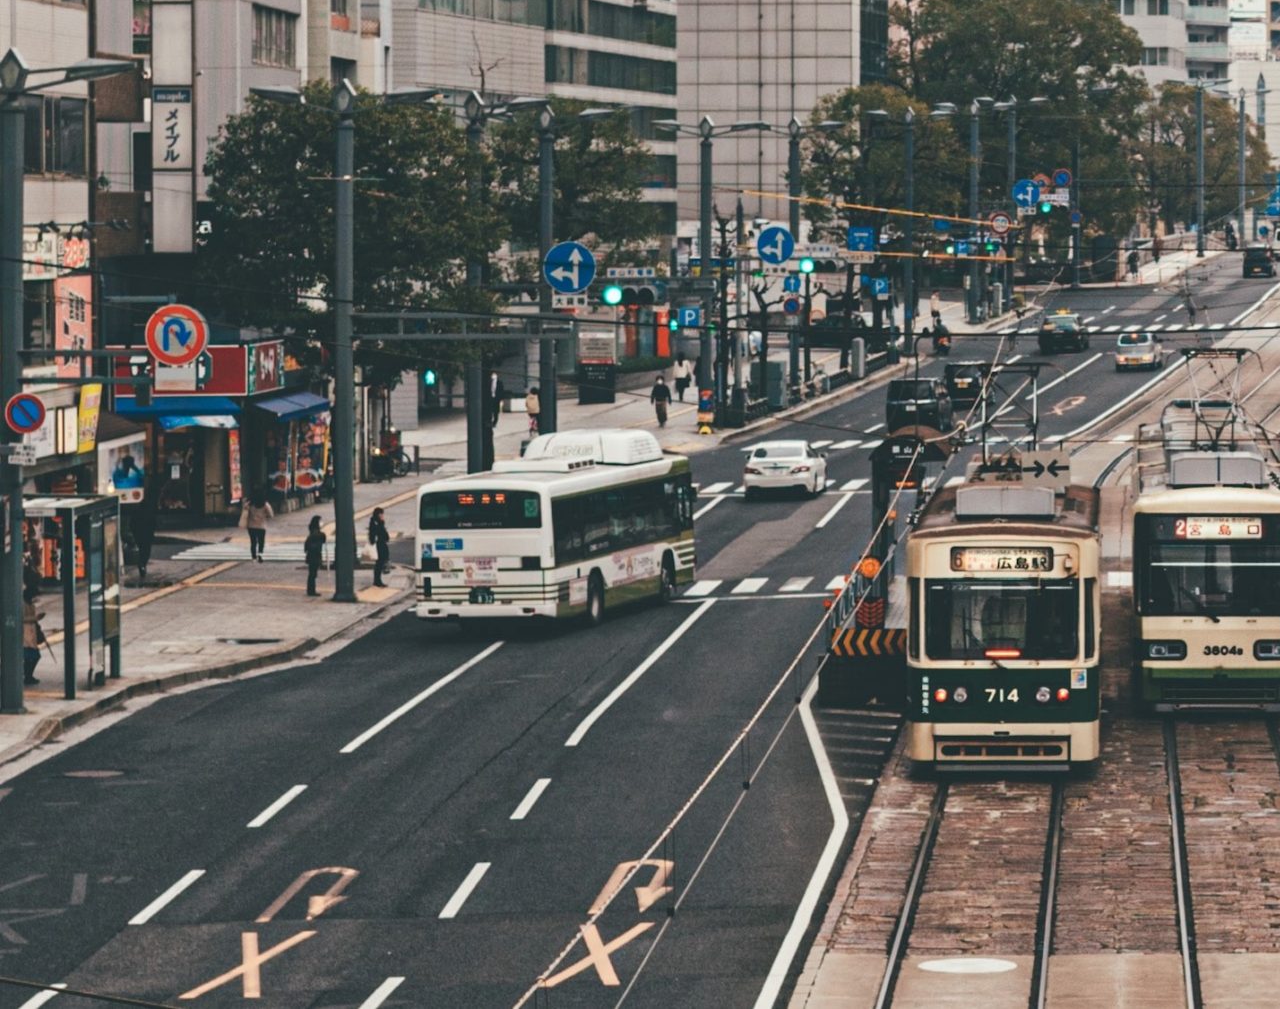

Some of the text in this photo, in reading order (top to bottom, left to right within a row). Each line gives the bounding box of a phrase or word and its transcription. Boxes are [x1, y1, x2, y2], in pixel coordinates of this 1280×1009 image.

[685, 310, 696, 326] P
[1175, 520, 1186, 536] 2
[1189, 523, 1260, 536] 宮島口
[954, 553, 963, 569] 6
[997, 557, 1048, 570] 広島駅
[984, 688, 1020, 703] 714
